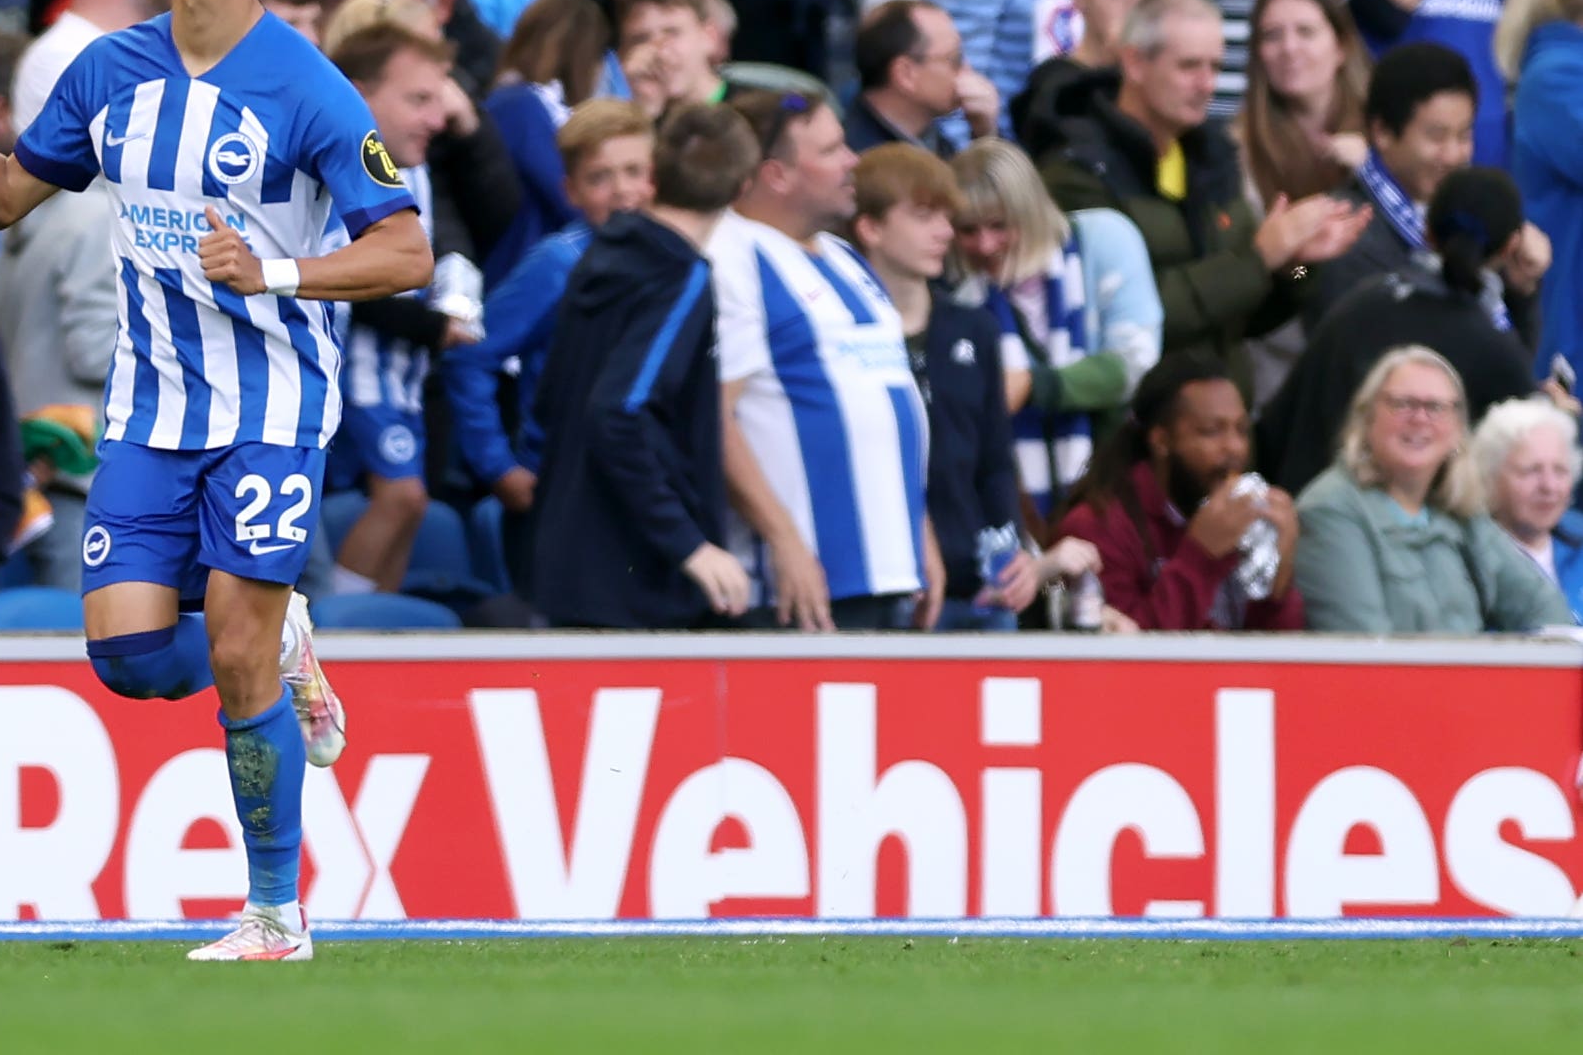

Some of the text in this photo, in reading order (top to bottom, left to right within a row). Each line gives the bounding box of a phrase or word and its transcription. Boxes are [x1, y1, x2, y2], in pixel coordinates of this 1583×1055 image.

[119, 201, 246, 232] AMERICN
[134, 228, 253, 255] EXPR
[235, 474, 312, 543] 22
[469, 677, 1578, 920] Vehicles
